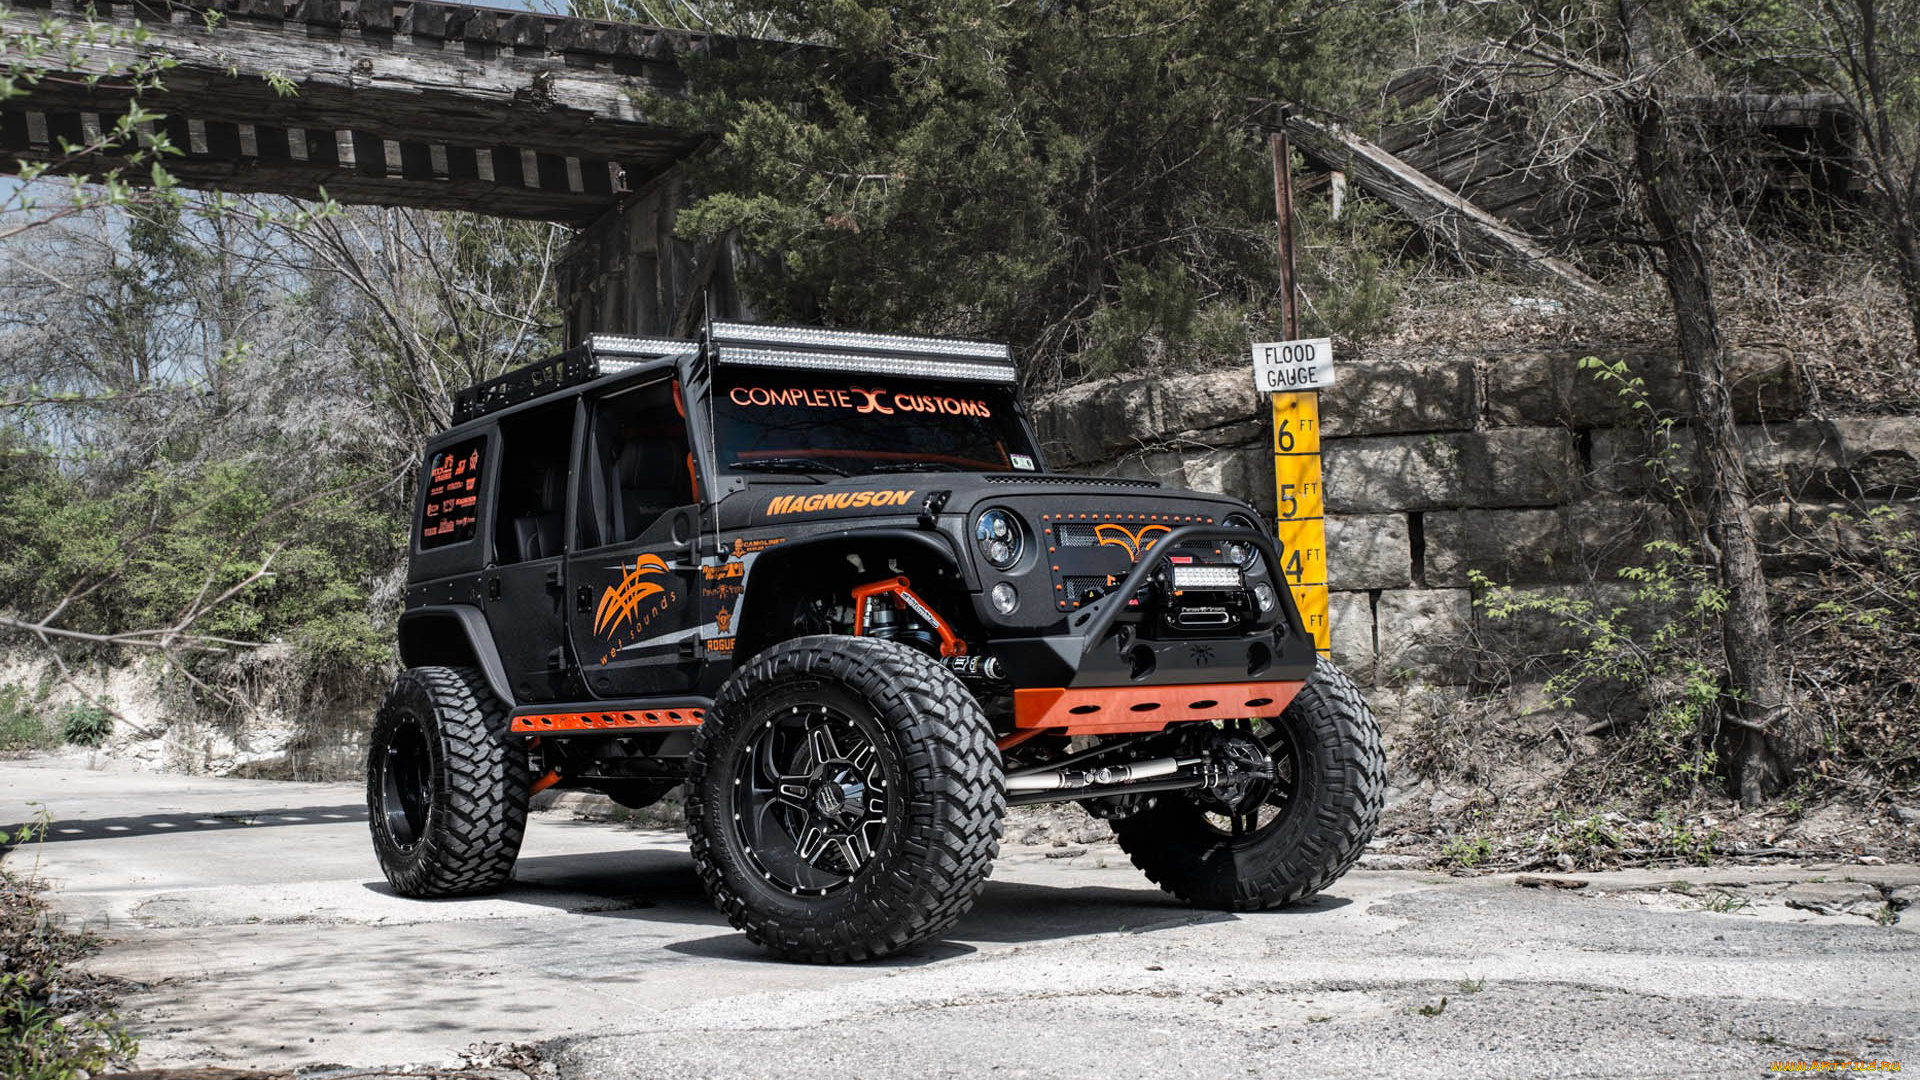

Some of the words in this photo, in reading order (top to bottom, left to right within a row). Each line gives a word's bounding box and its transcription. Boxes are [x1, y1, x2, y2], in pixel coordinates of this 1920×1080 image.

[1264, 344, 1315, 365] FLOOD
[1267, 366, 1318, 388] GAUGE
[729, 386, 852, 409] COMPLETE
[894, 393, 991, 418] CUSTOMS
[1278, 418, 1295, 452] 6
[1300, 419, 1314, 432] FT
[766, 490, 915, 517] MAGNUSON
[1280, 483, 1297, 518] 5
[1303, 482, 1318, 495] FT
[1285, 549, 1303, 584] 4
[1306, 548, 1321, 561] FT
[600, 638, 622, 667] wet
[629, 591, 677, 641] sounds
[1310, 614, 1324, 627] FT
[706, 638, 736, 653] ROGUE
